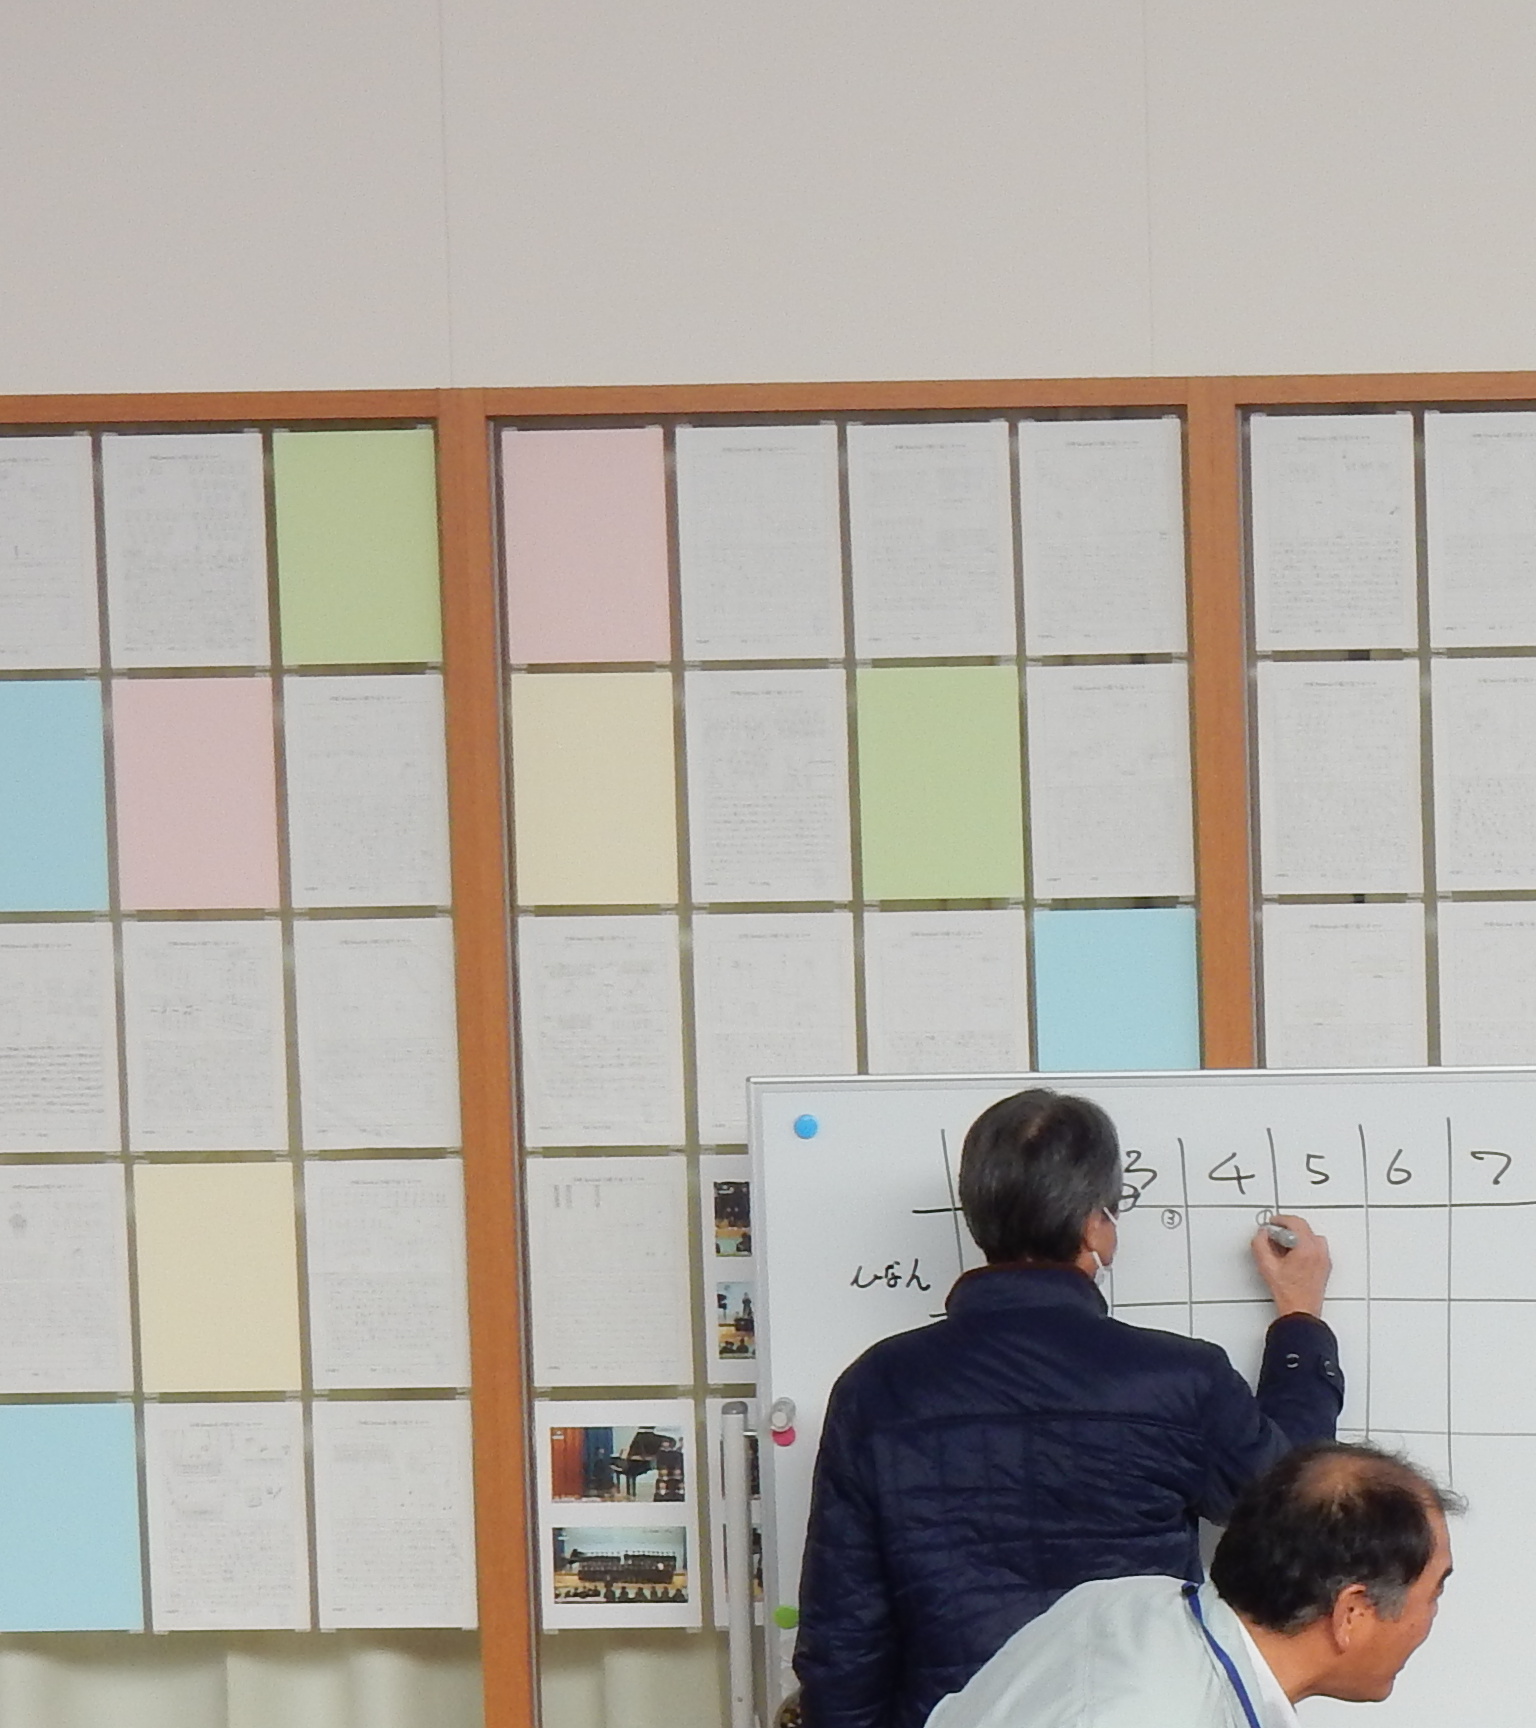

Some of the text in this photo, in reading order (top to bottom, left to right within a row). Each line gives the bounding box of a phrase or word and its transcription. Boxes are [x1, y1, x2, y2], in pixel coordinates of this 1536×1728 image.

[1124, 1149, 1158, 1191] 3
[1208, 1151, 1256, 1196] 4
[1305, 1154, 1331, 1186] 5
[1385, 1148, 1413, 1186] 6
[1470, 1149, 1513, 1186] 7
